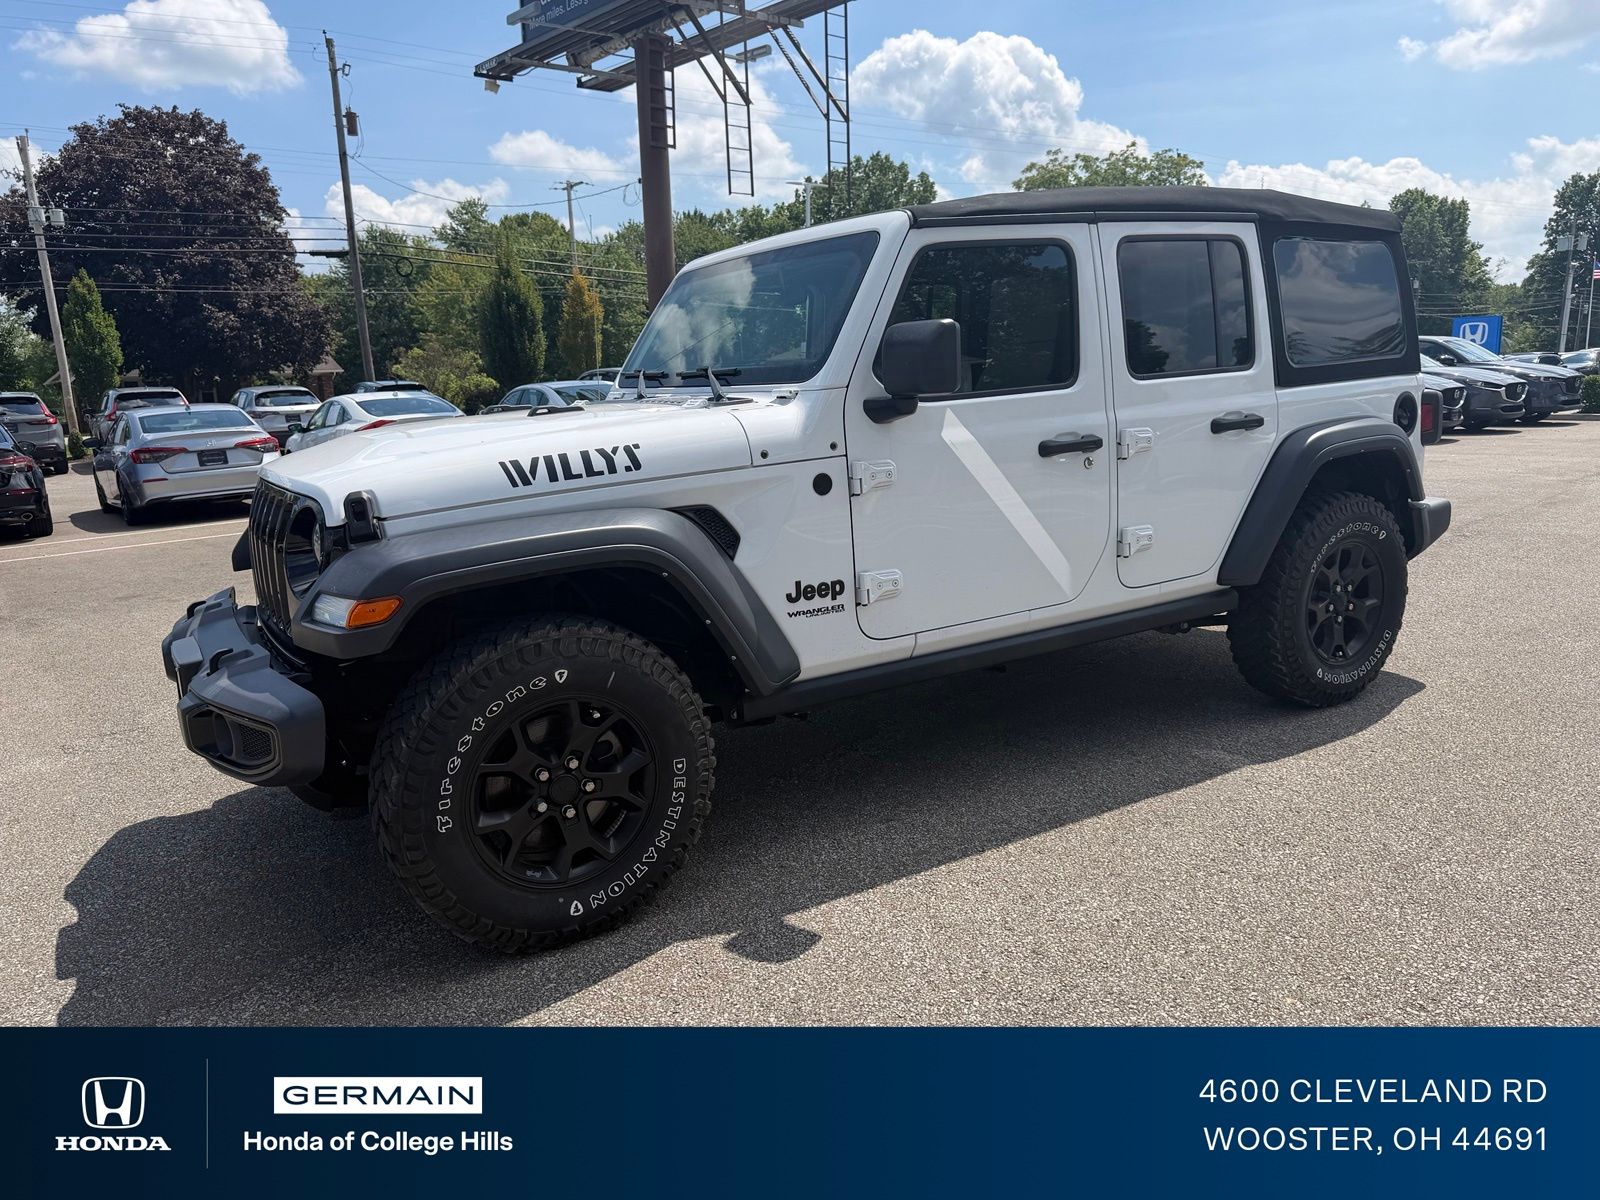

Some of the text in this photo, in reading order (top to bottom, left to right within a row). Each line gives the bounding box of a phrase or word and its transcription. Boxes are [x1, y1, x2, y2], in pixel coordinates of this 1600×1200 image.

[498, 443, 642, 488] WILLYS
[786, 579, 845, 603] Jeep
[787, 604, 845, 618] WRANGLER
[1324, 630, 1391, 684] DESTINATION
[437, 676, 547, 832] Firestone
[590, 758, 686, 909] DESTINATION
